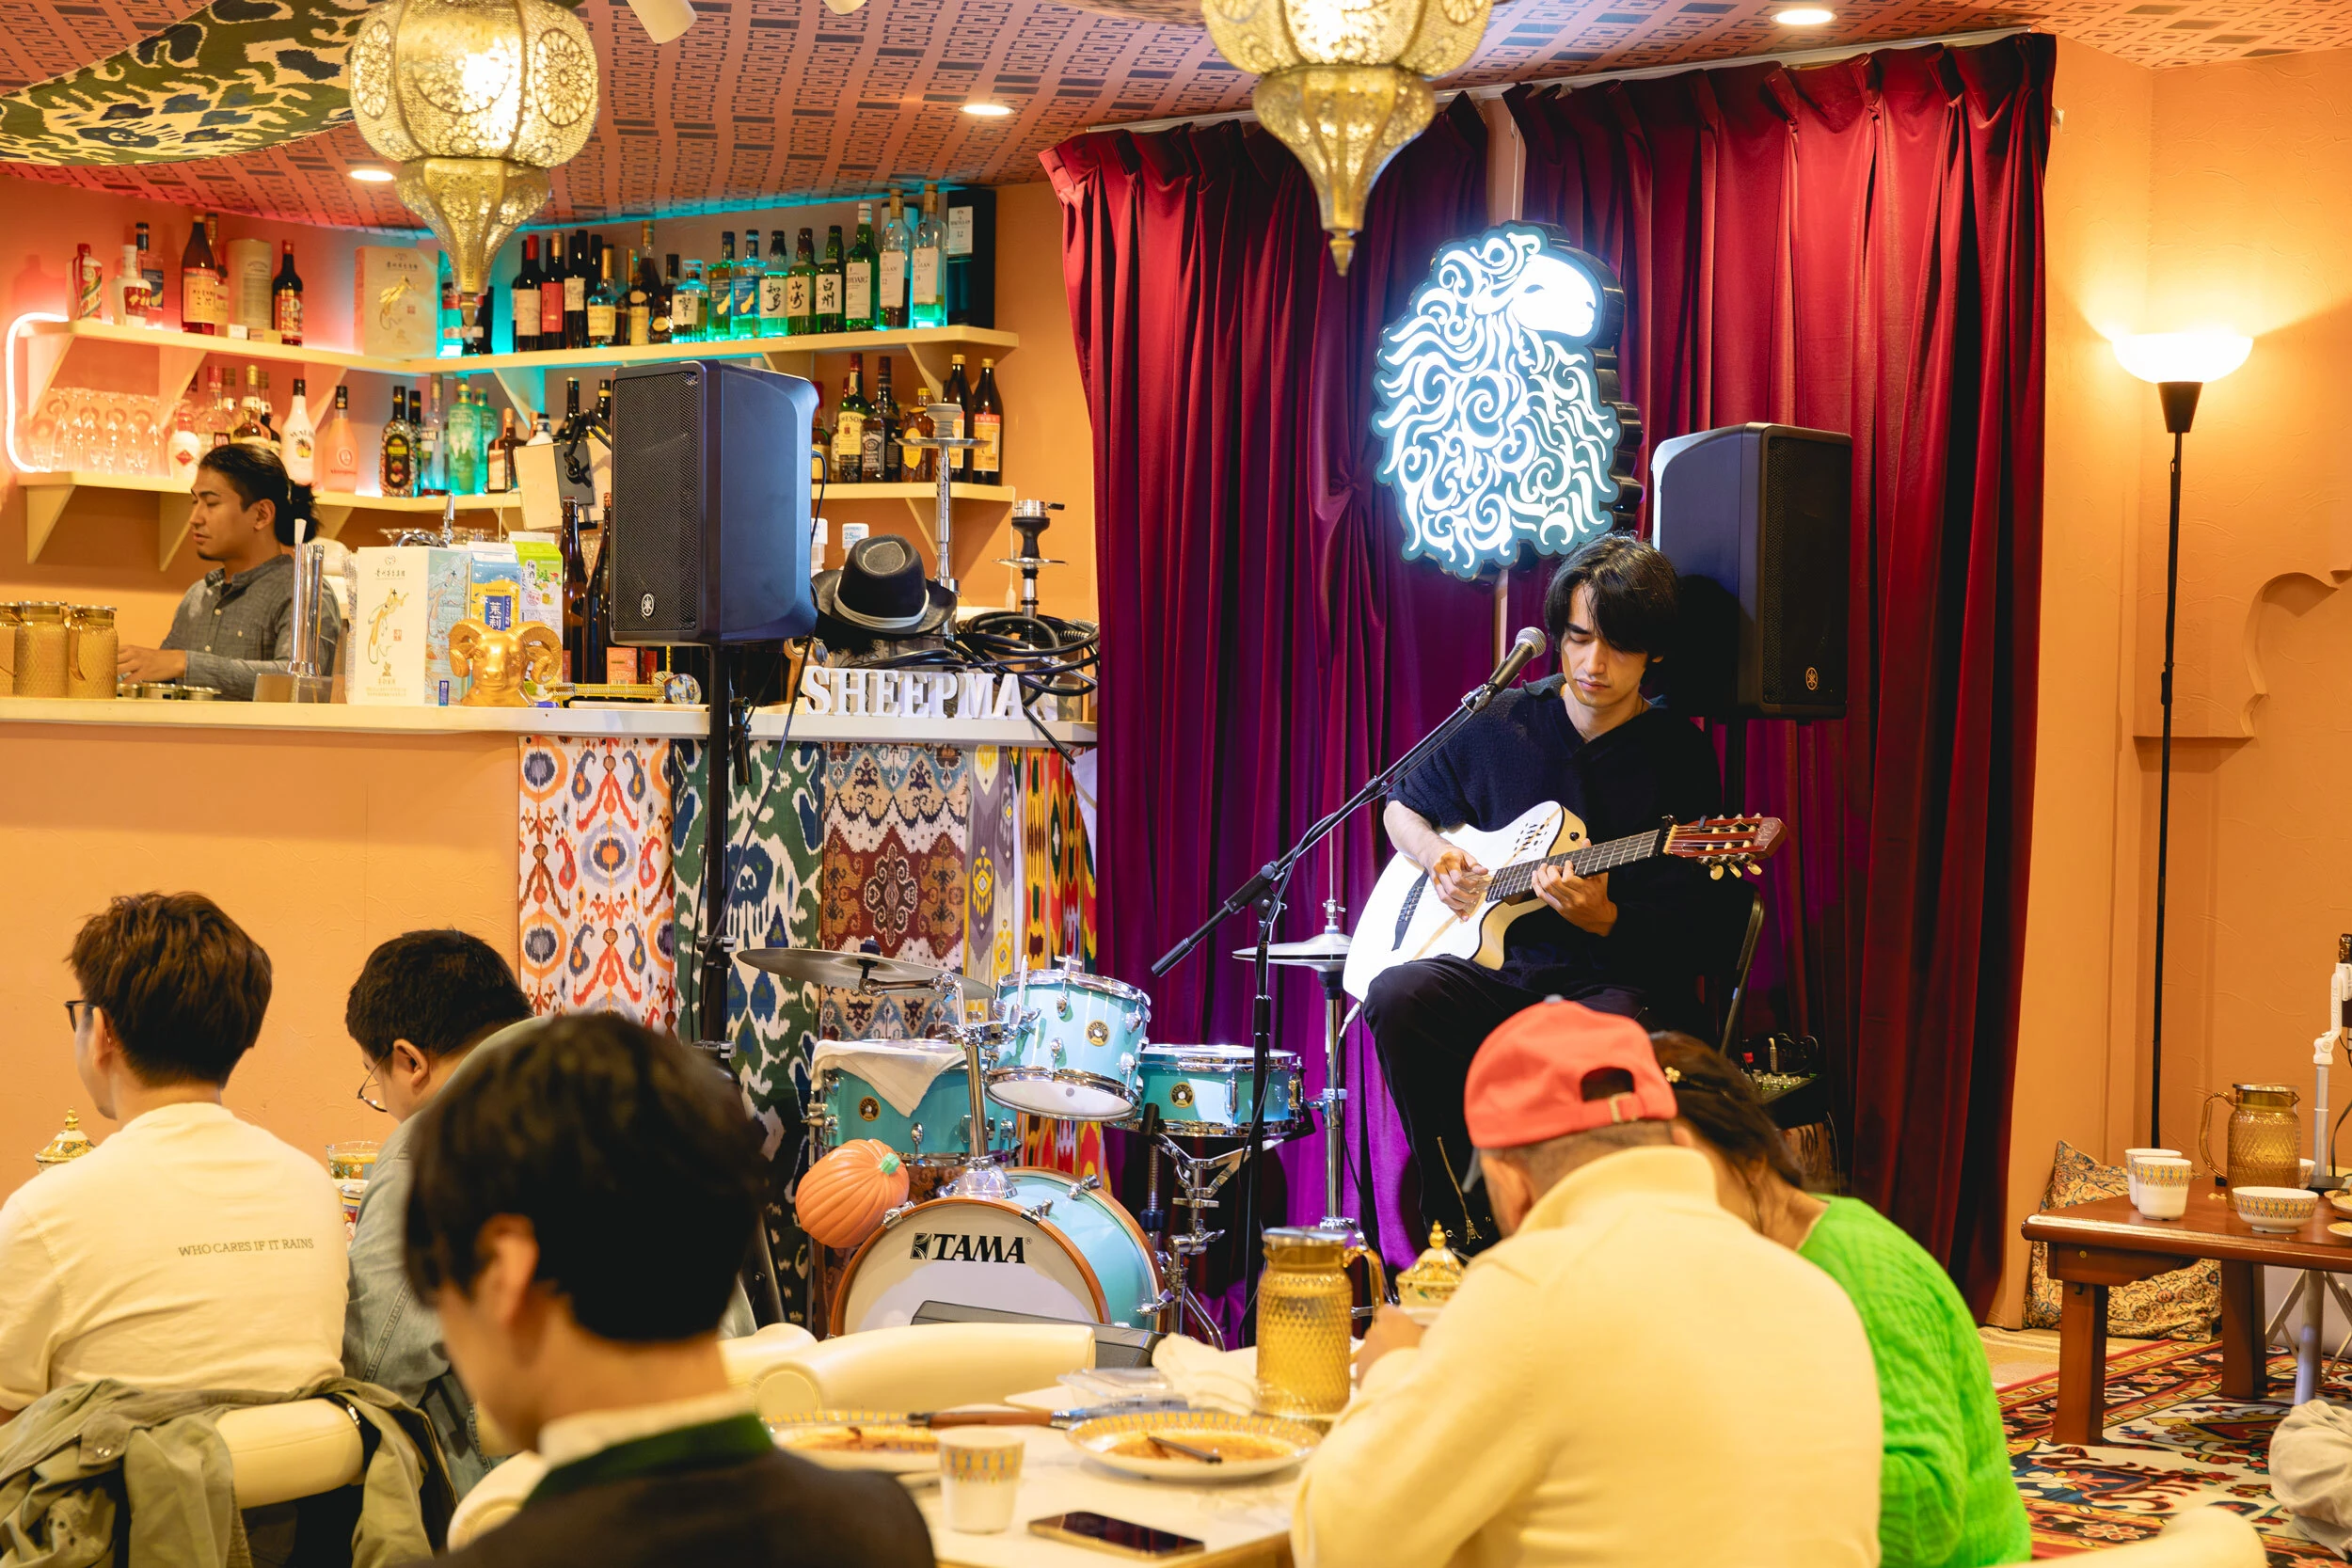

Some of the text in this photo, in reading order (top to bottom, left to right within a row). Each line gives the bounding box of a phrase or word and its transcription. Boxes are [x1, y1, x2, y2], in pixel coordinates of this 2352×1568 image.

[766, 283, 781, 311] 知多
[821, 277, 834, 309] 白州
[179, 1238, 314, 1257] WHO CARES IF IT RAINS
[931, 1233, 1025, 1263] TAMA
